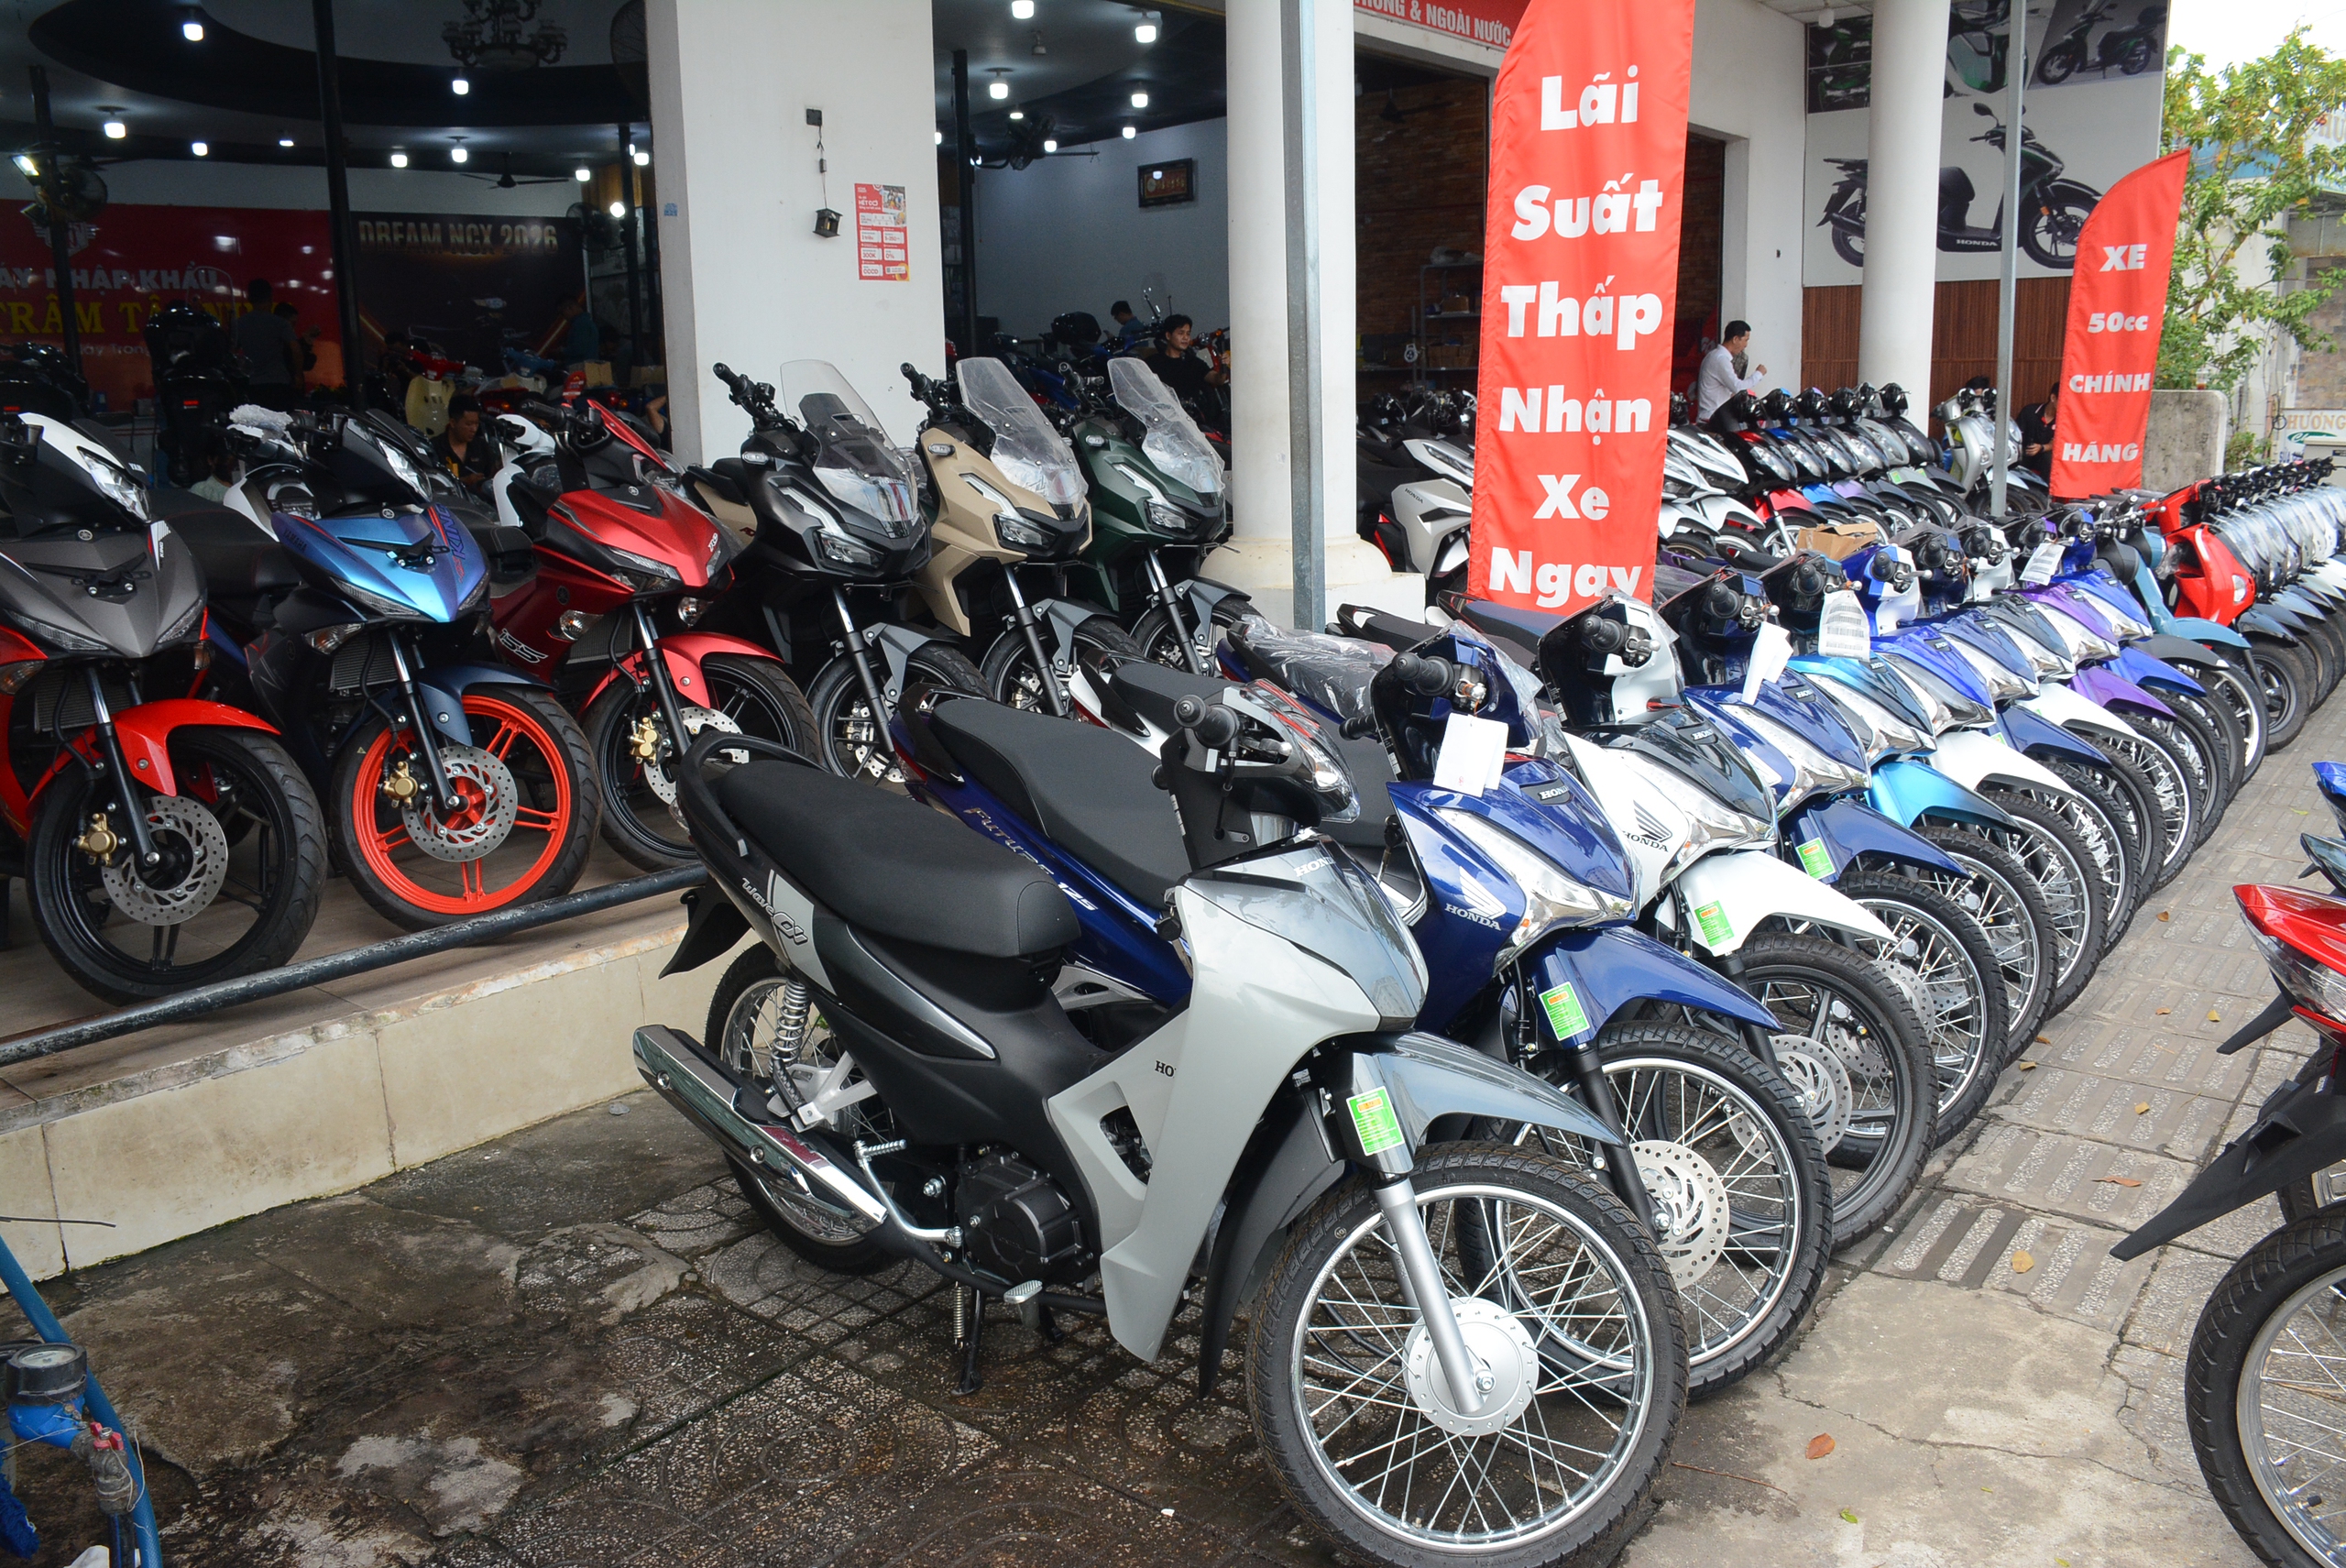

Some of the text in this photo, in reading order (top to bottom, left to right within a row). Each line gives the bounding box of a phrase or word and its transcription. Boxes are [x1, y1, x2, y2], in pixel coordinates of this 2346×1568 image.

[1354, 0, 1511, 46] ONG & NGOÀI NƯỚC
[1540, 64, 1639, 131] Lãi
[1510, 172, 1663, 241] Suất
[2099, 244, 2147, 272] XE
[1500, 275, 1663, 350] Thấp
[2088, 312, 2149, 334] 50cc
[2069, 370, 2152, 393] CHÍNH
[1498, 385, 1652, 445] Nhận
[2062, 441, 2139, 463] HÃNG
[1405, 488, 1424, 504] HONDA
[1532, 474, 1610, 521] Xe
[1488, 546, 1643, 609] Ngay
[1539, 785, 1569, 800] HON
[1293, 856, 1336, 877] HON
[1444, 903, 1502, 931] HONDA
